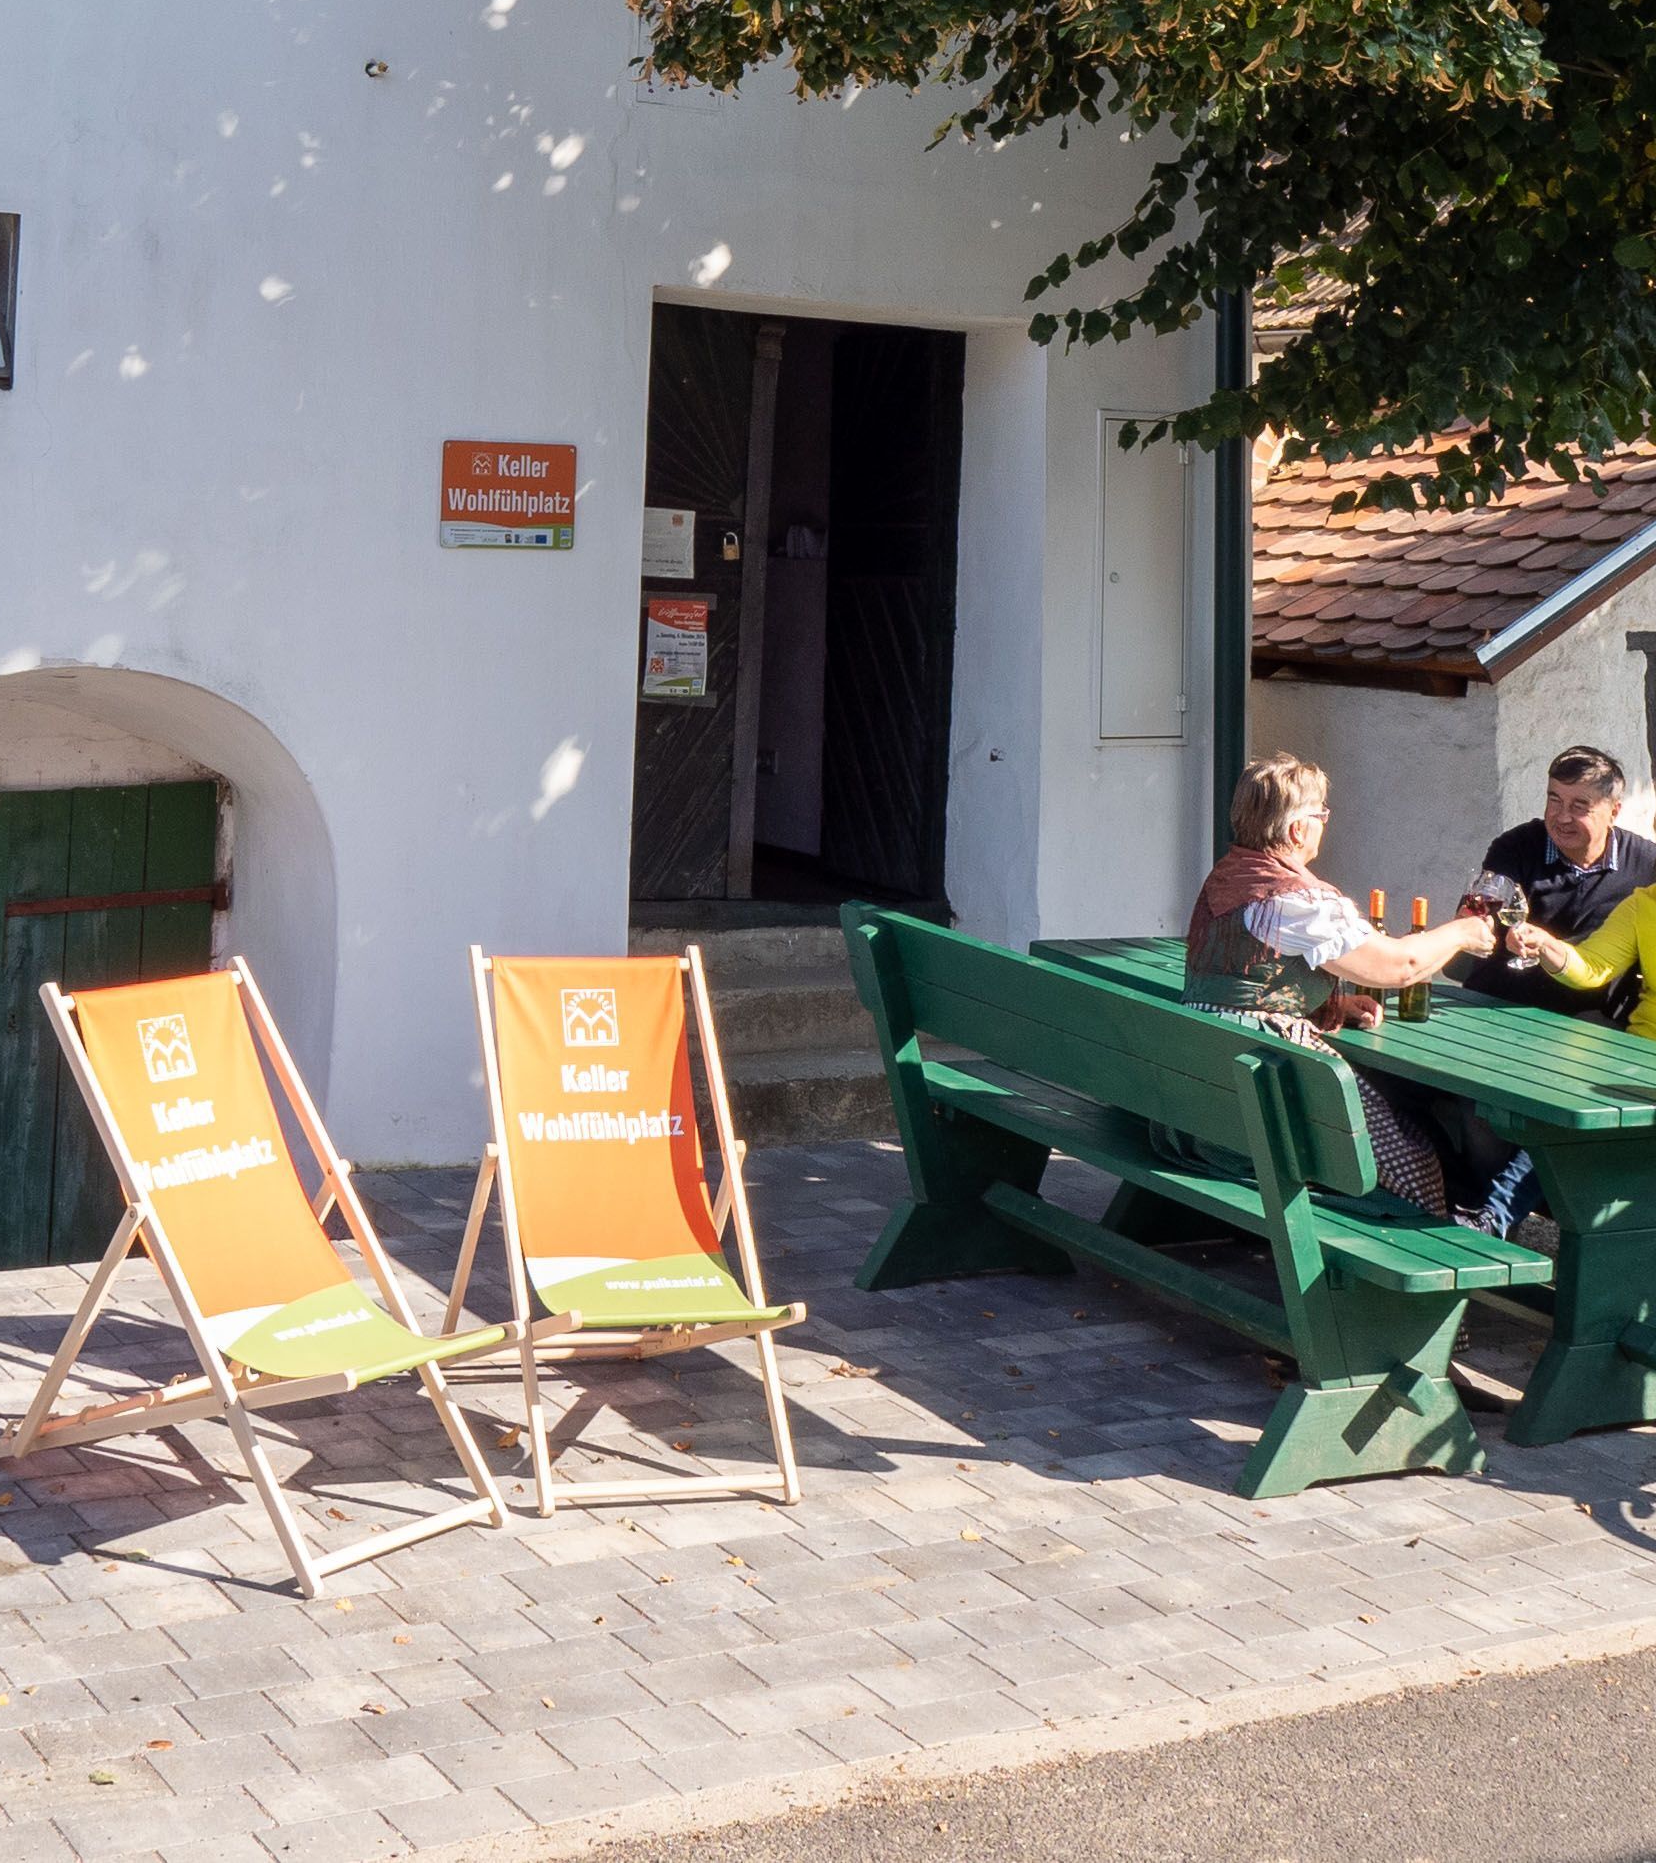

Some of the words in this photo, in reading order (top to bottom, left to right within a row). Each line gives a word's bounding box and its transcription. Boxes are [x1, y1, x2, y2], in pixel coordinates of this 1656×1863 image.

[498, 454, 550, 478] Keller
[448, 488, 571, 518] Wohlfühlplatz
[561, 1064, 630, 1093] Keller
[151, 1097, 216, 1134] Keller
[518, 1109, 685, 1145] Wohlfühlplatz
[132, 1136, 278, 1193] Wohlfühlplatz
